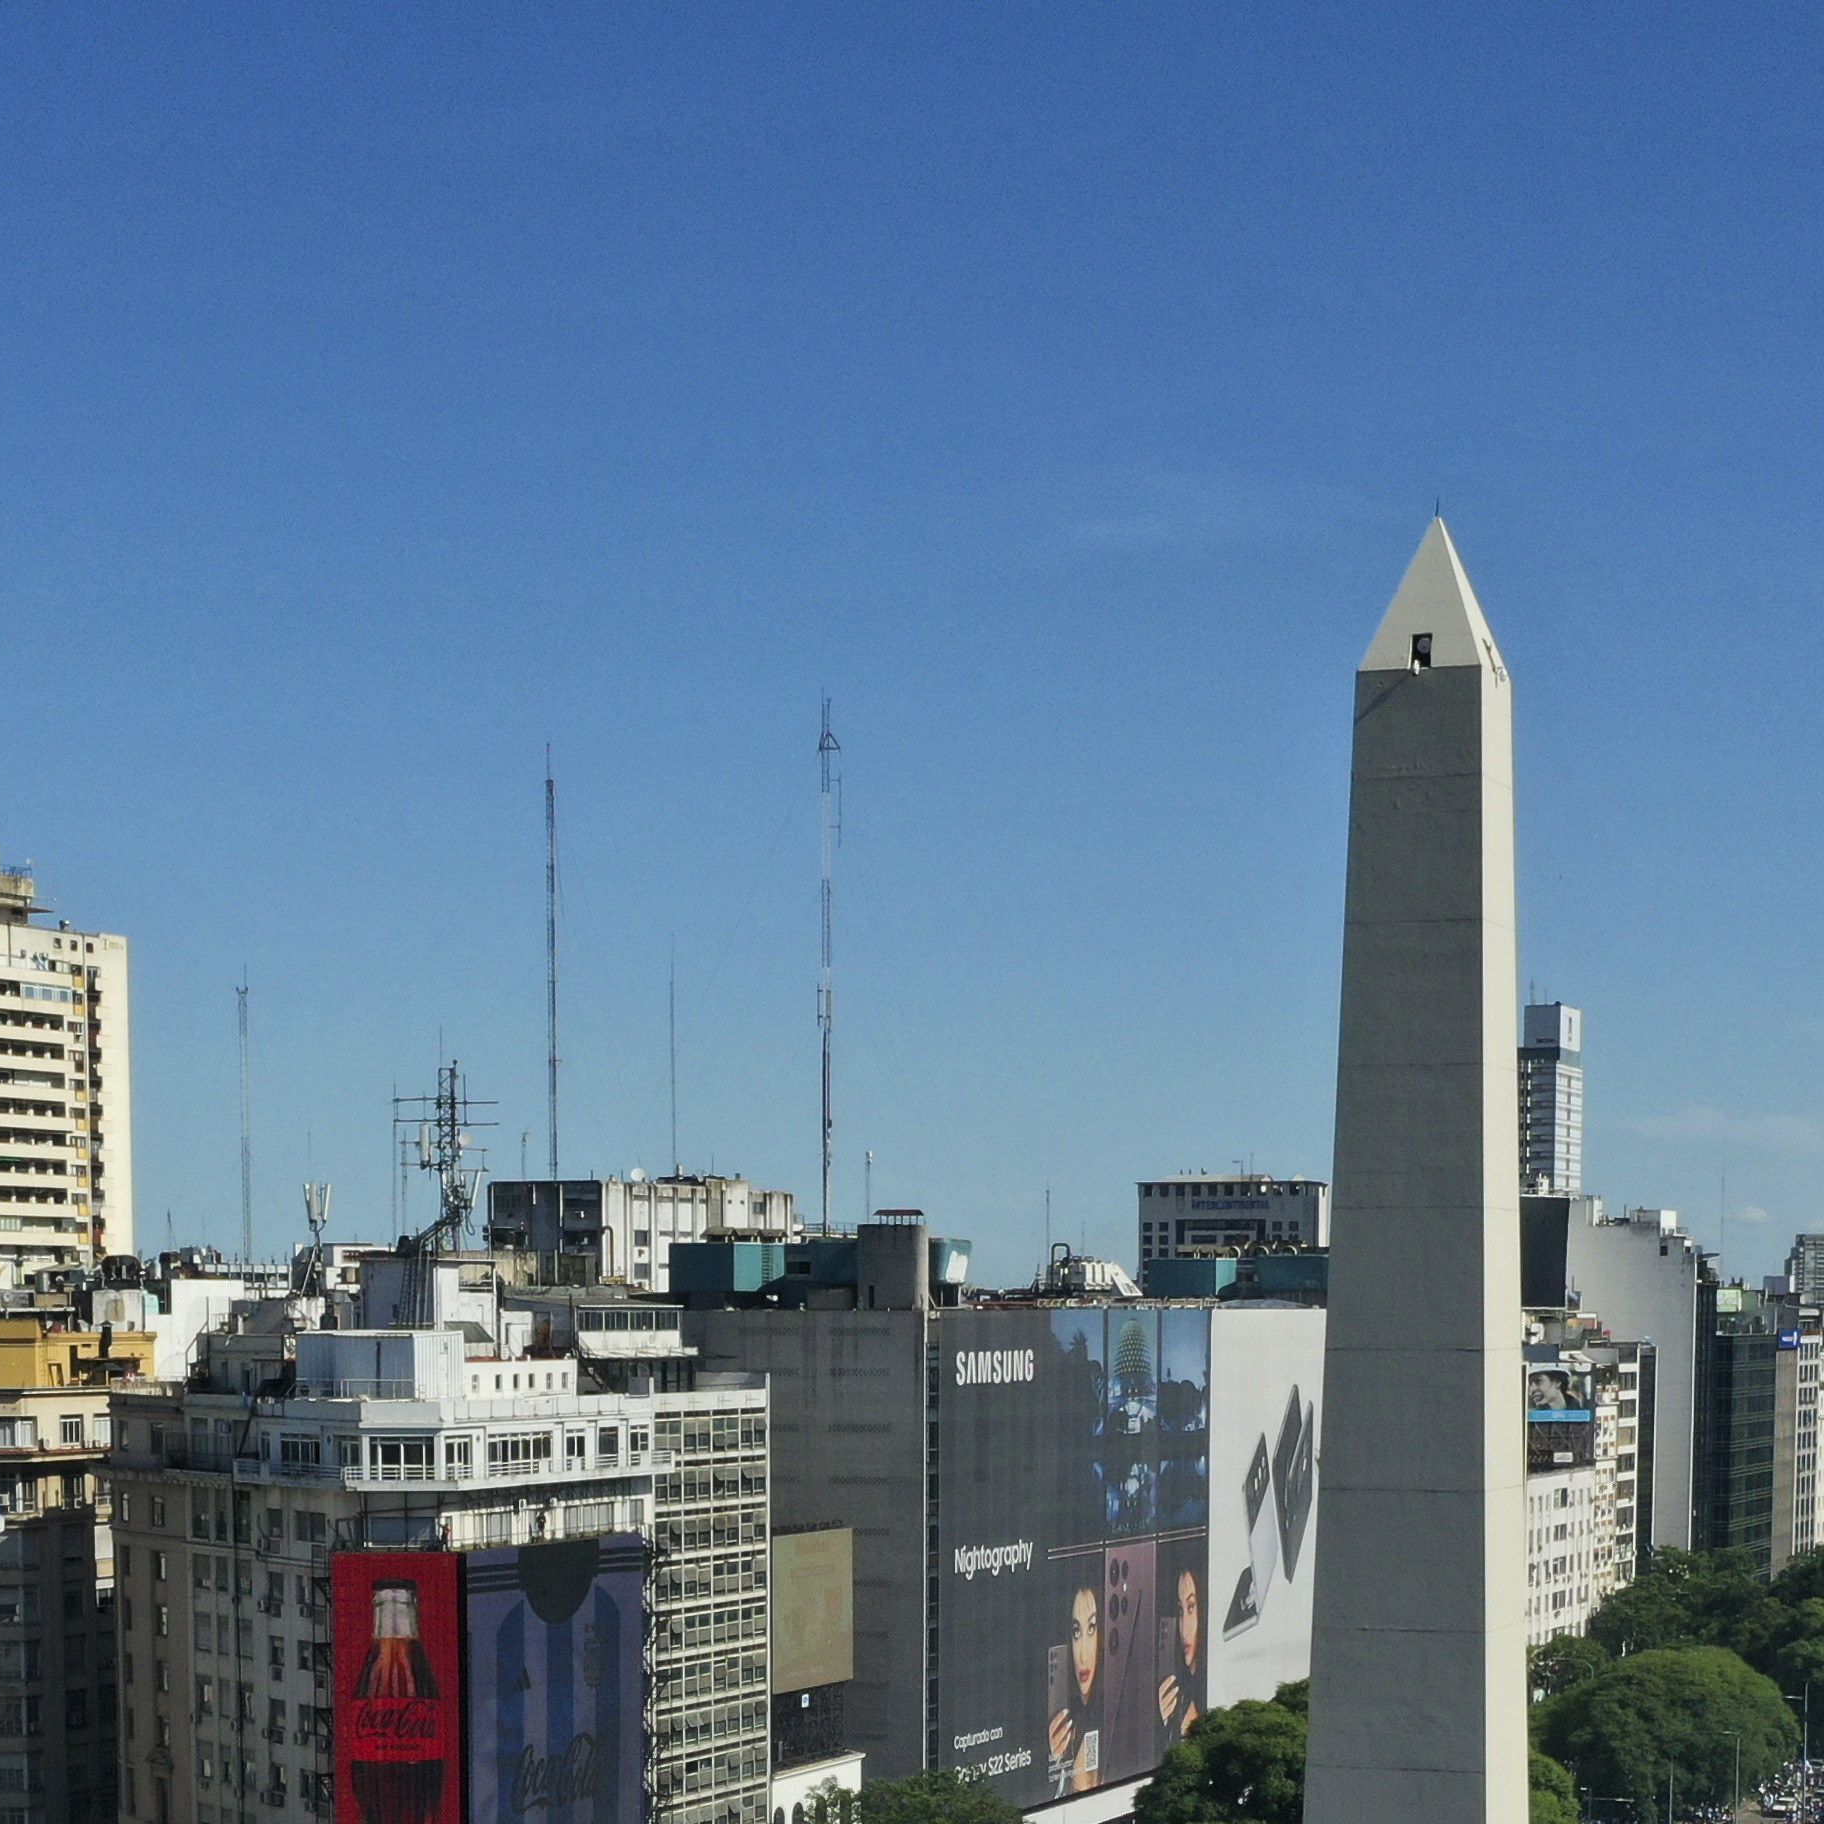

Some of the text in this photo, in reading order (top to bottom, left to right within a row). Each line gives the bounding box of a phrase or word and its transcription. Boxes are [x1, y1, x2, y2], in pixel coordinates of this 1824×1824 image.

[955, 1348, 1034, 1386] SAMSUNG
[954, 1538, 1034, 1580] Nightography
[954, 1726, 1004, 1752] Capturado con
[988, 1753, 1005, 1777] S22
[1004, 1747, 1032, 1772] Series
